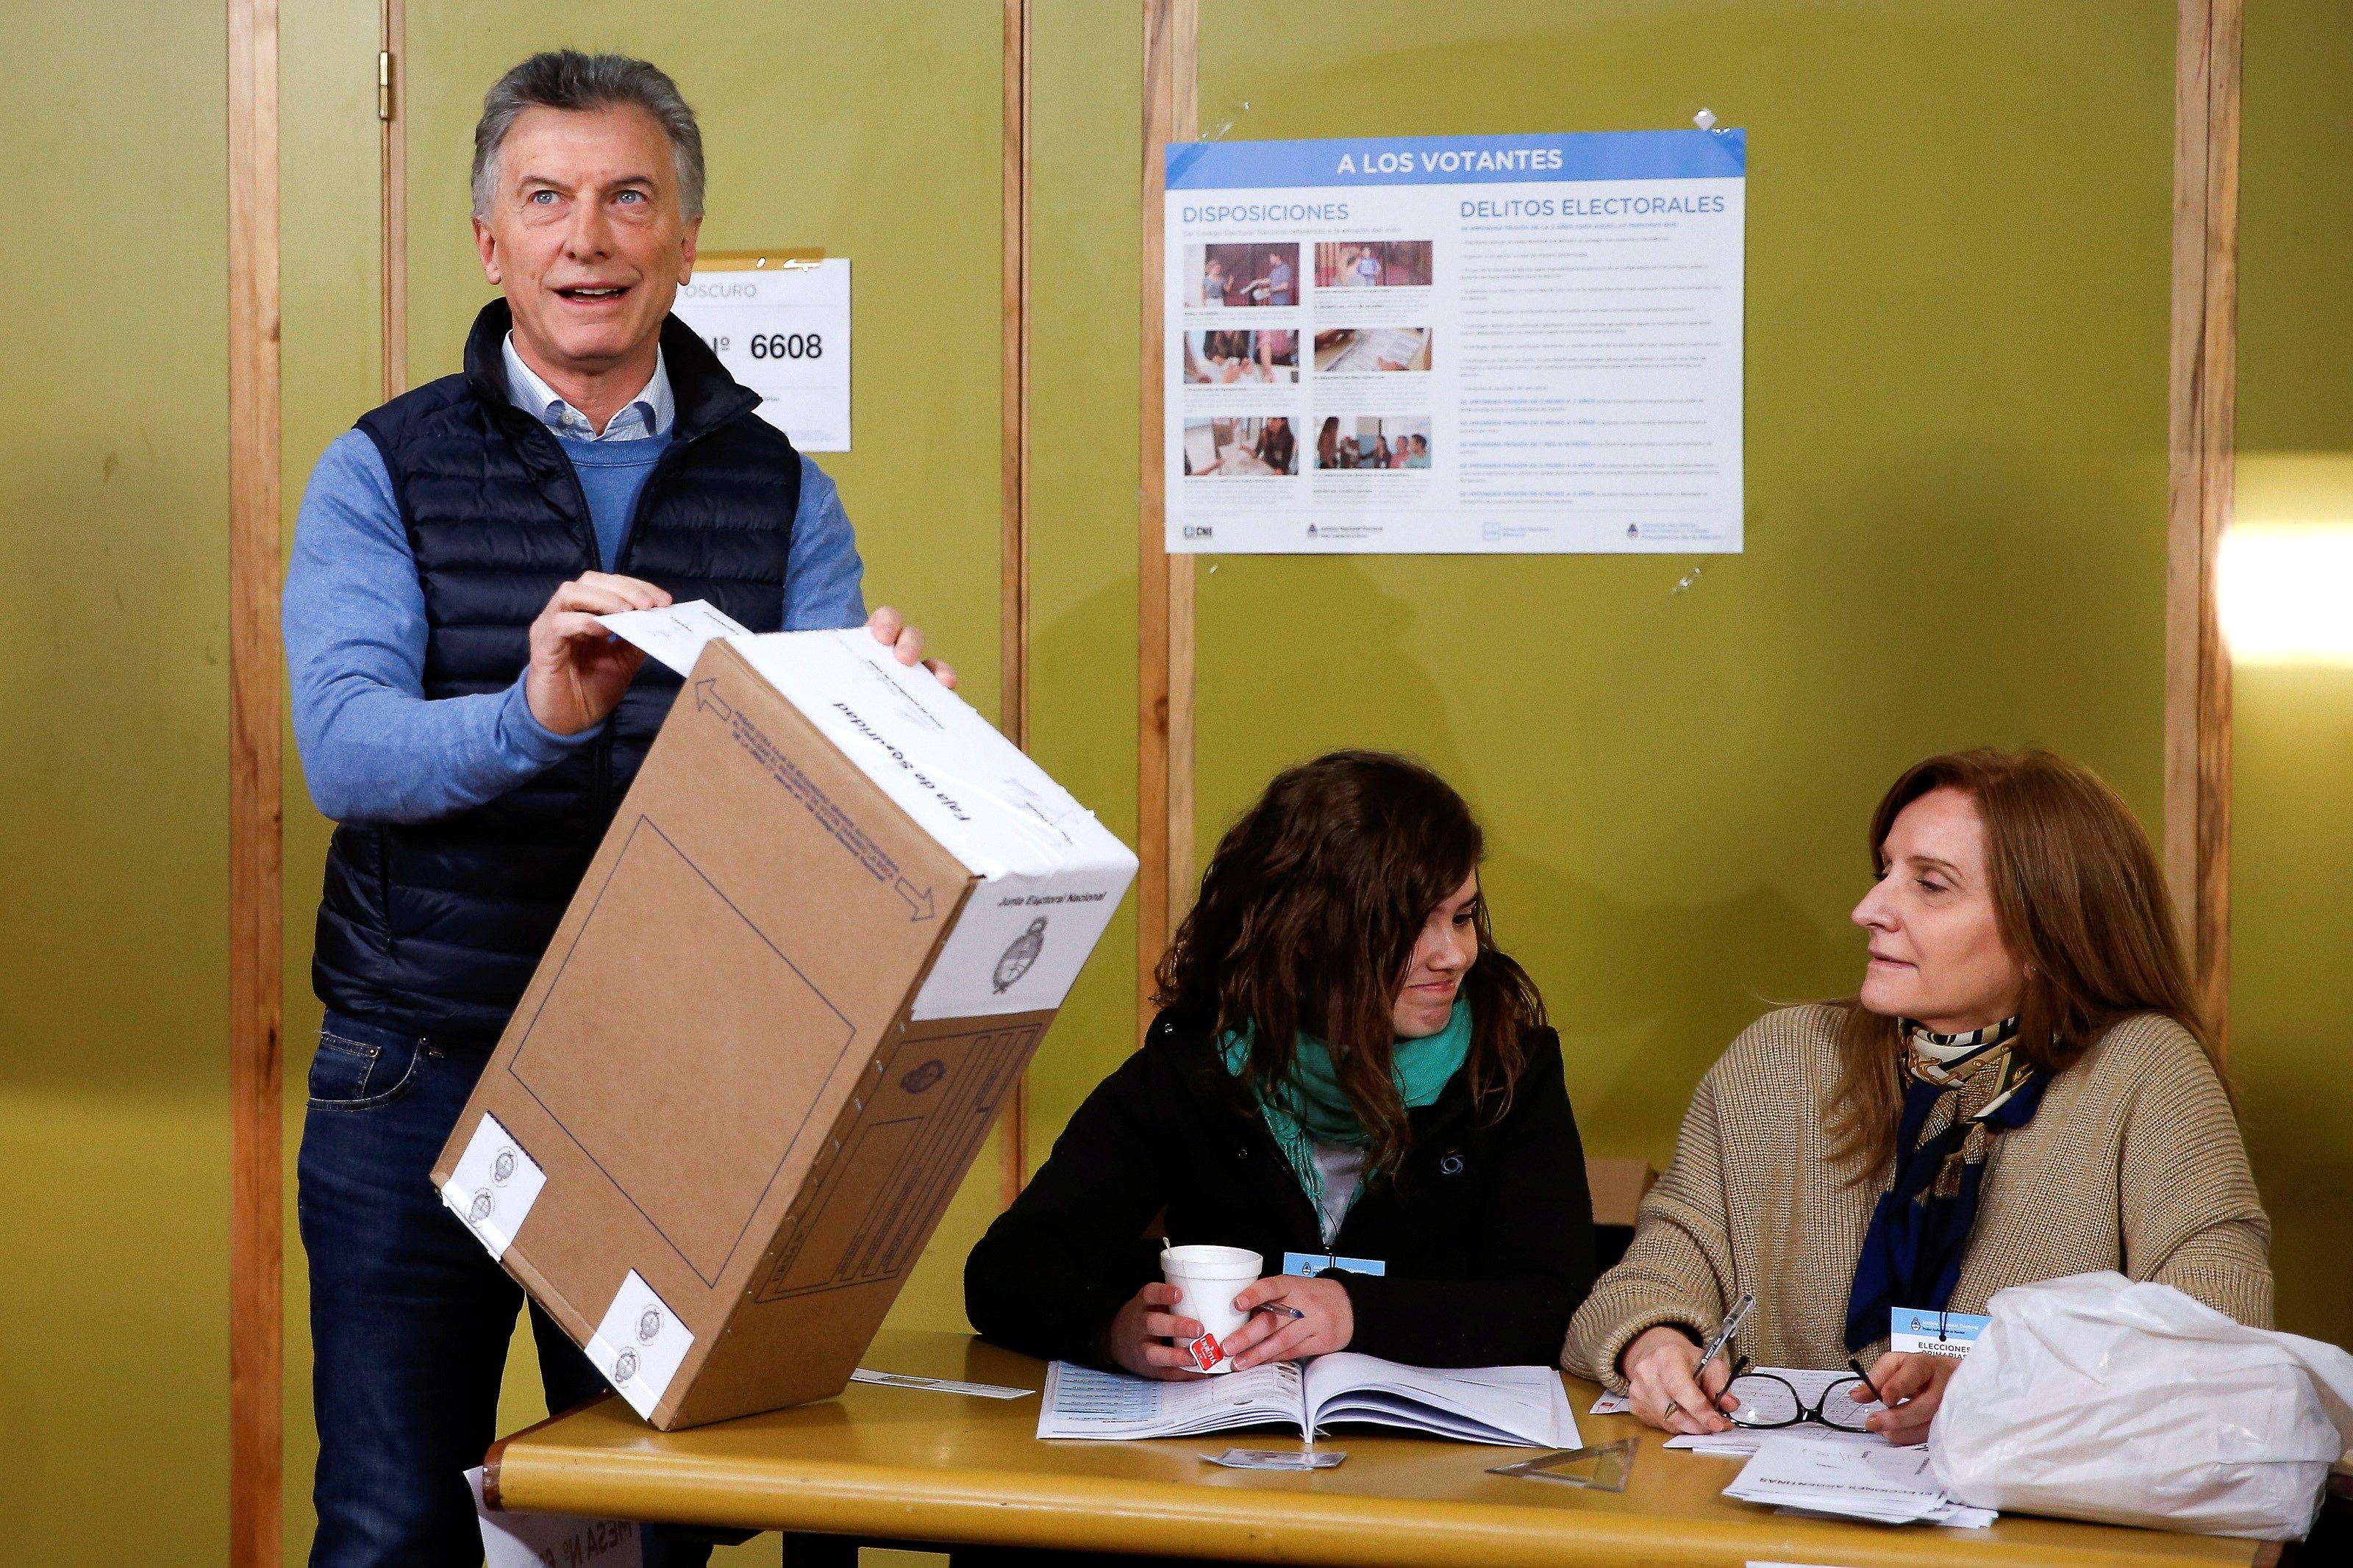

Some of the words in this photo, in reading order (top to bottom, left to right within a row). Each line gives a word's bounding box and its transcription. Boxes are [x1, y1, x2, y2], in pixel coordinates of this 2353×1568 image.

[1337, 154, 1356, 175] A
[1363, 151, 1414, 174] LOS
[1420, 148, 1563, 173] VOTANTES
[1182, 204, 1349, 223] DISPOSICIONES
[1461, 199, 1556, 218] DELITOS
[1563, 196, 1725, 216] ELECTORALES
[685, 284, 757, 298] OSCURO
[751, 334, 822, 359] 6608
[915, 773, 935, 789] de
[937, 793, 971, 820] Faja
[1918, 1342, 1971, 1353] ELECCIONES
